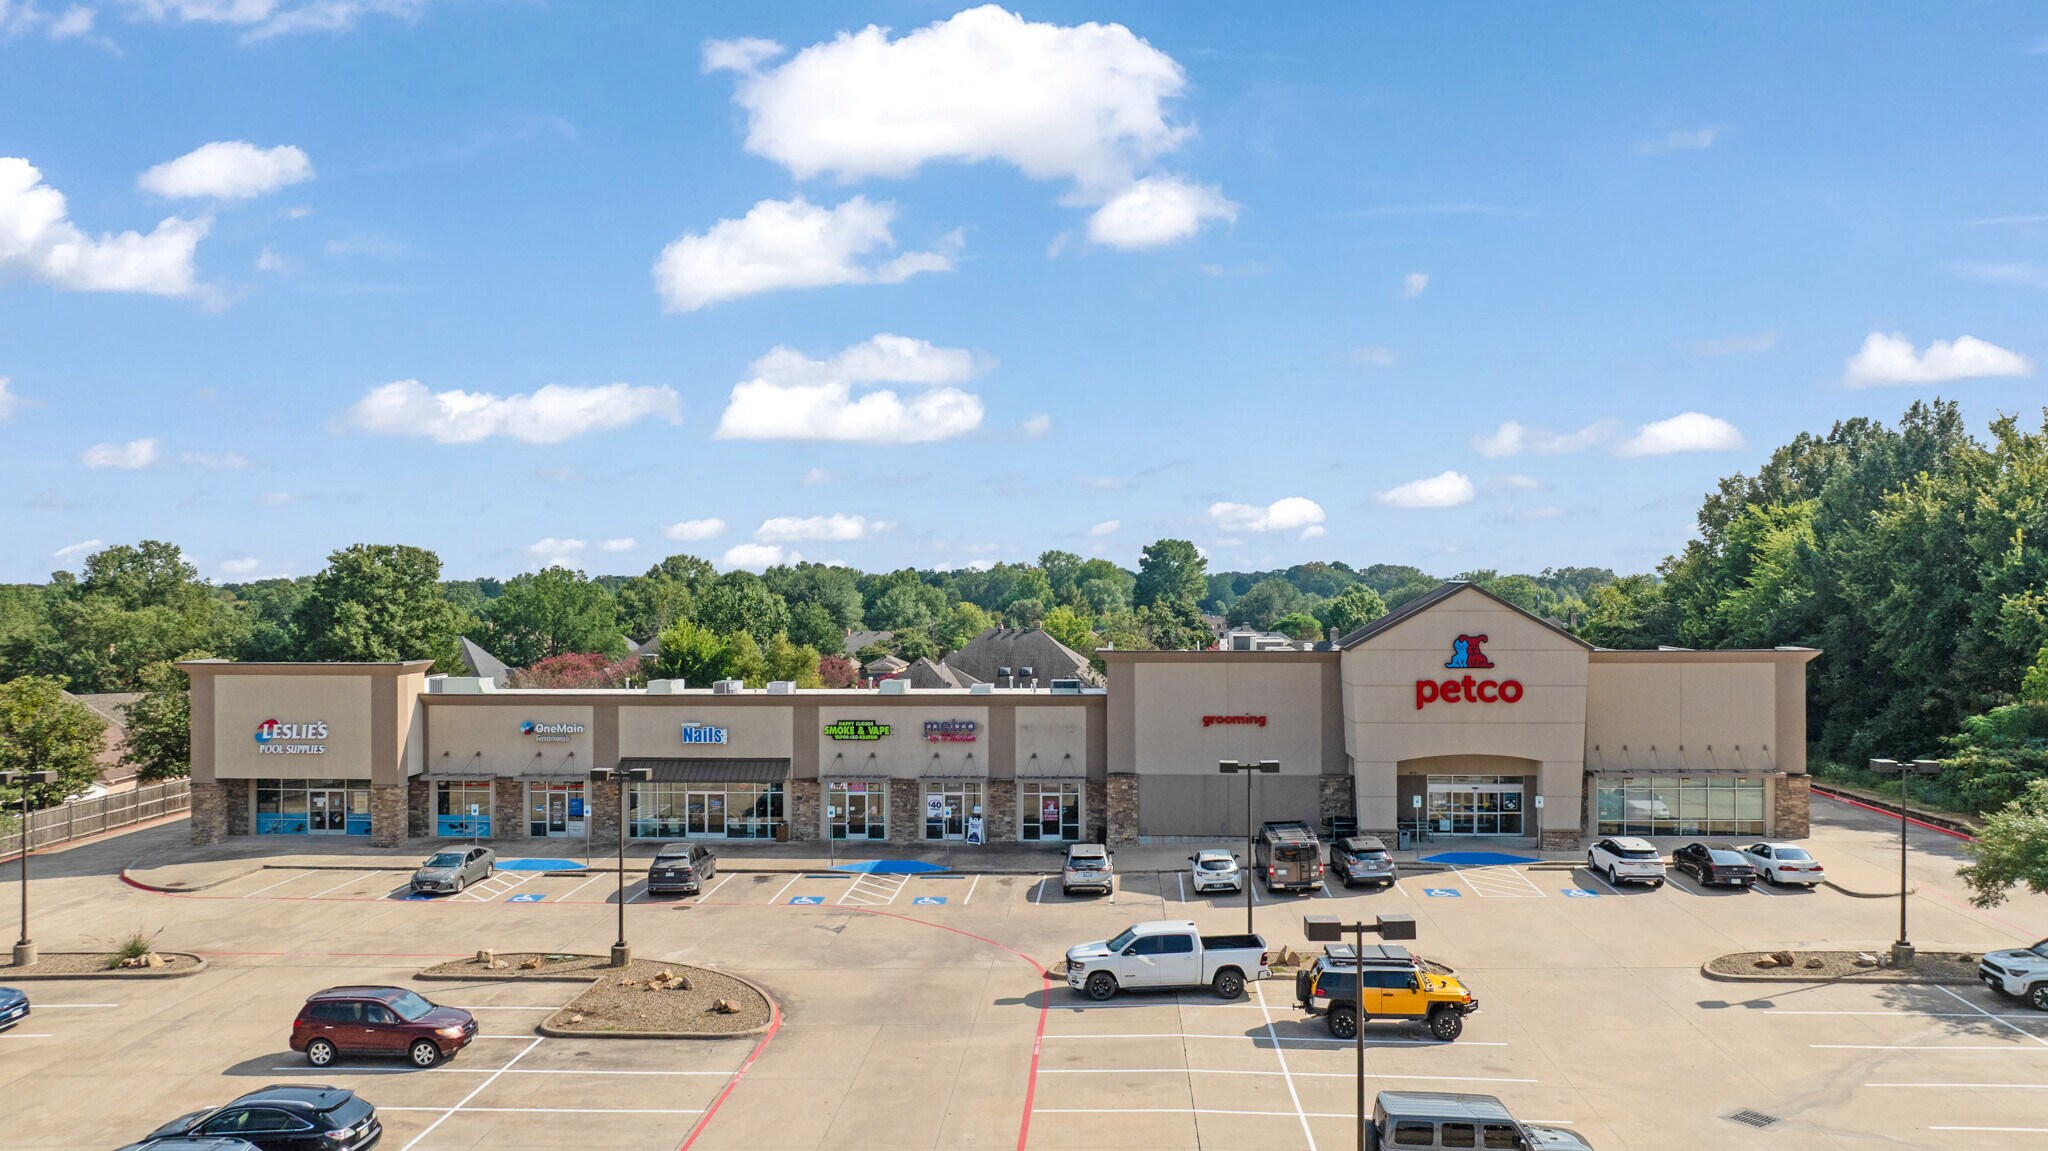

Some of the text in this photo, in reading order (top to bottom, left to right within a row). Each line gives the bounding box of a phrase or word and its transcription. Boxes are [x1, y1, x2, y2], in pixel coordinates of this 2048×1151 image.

[1416, 675, 1524, 710] petco
[924, 719, 976, 732] metro
[1202, 713, 1267, 727] grooming
[262, 720, 328, 739] LESLIE'S
[535, 723, 585, 733] OneMain
[682, 726, 723, 743] Nails
[824, 726, 890, 735] SMOKE & VAPE
[259, 744, 325, 754] POOL SUPPLIES
[927, 801, 942, 809] $40
